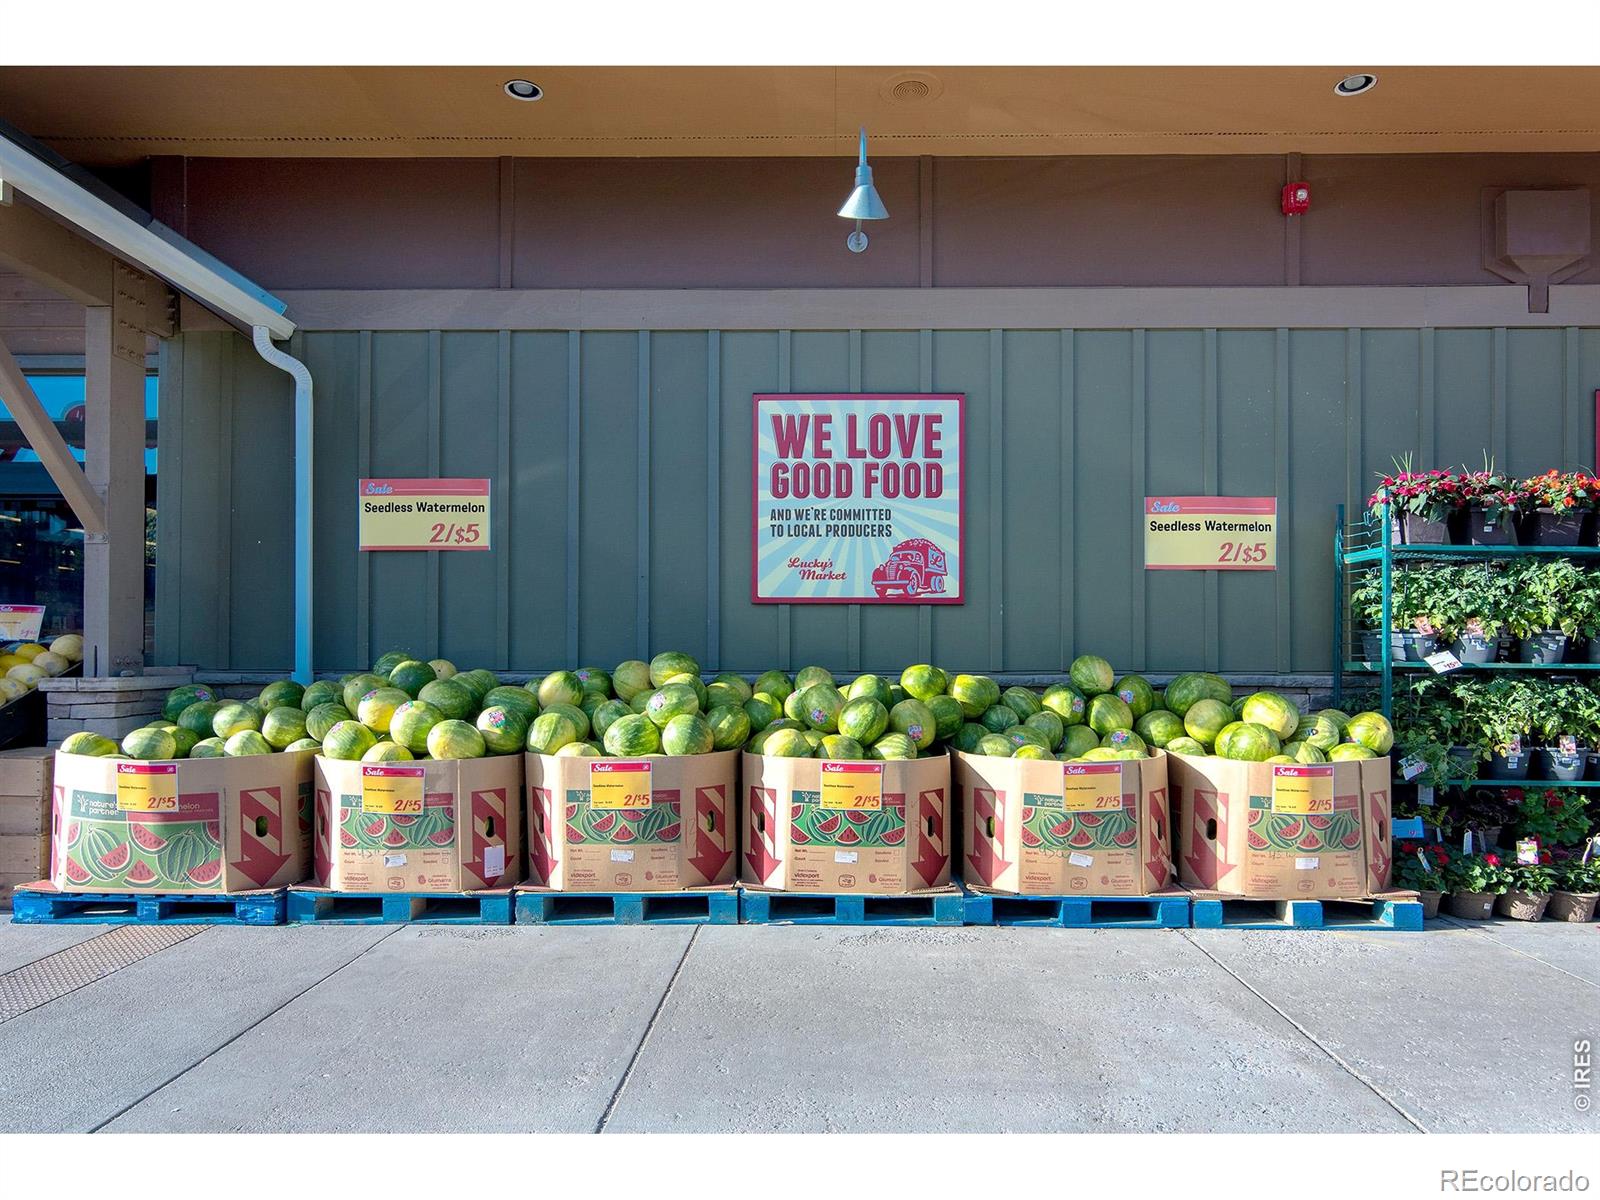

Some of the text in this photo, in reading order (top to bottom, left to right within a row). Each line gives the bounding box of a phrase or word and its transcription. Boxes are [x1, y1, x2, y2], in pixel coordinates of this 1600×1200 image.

[770, 413, 943, 459] WE LOVE
[770, 461, 944, 499] GOOD FOOD
[365, 482, 393, 495] Sale
[364, 502, 485, 513] Seedless Watermelon
[1151, 501, 1180, 513] Sale
[770, 507, 892, 521] AND WE'RE COMMITTED
[770, 524, 892, 537] TO LOCAL PRODUCERS
[1149, 521, 1272, 532] Seedless Watermelon
[430, 523, 480, 545] 2/$5
[1218, 542, 1267, 563] 2/$5
[787, 557, 833, 570] Lucky's
[798, 569, 847, 581] Market
[119, 764, 137, 774] Sale
[365, 768, 385, 776] Sale
[593, 763, 612, 772] Sale
[824, 764, 844, 772] Sale
[1066, 767, 1086, 775] Sale
[1277, 768, 1299, 776] Sale
[89, 800, 117, 809] nature'
[147, 796, 177, 809] 2/$5
[394, 800, 421, 812] 2/$5
[623, 794, 651, 807] 2/$5
[853, 795, 880, 808] 2/$5
[1095, 796, 1121, 809] 2/$5
[1308, 799, 1332, 812] 2/$5
